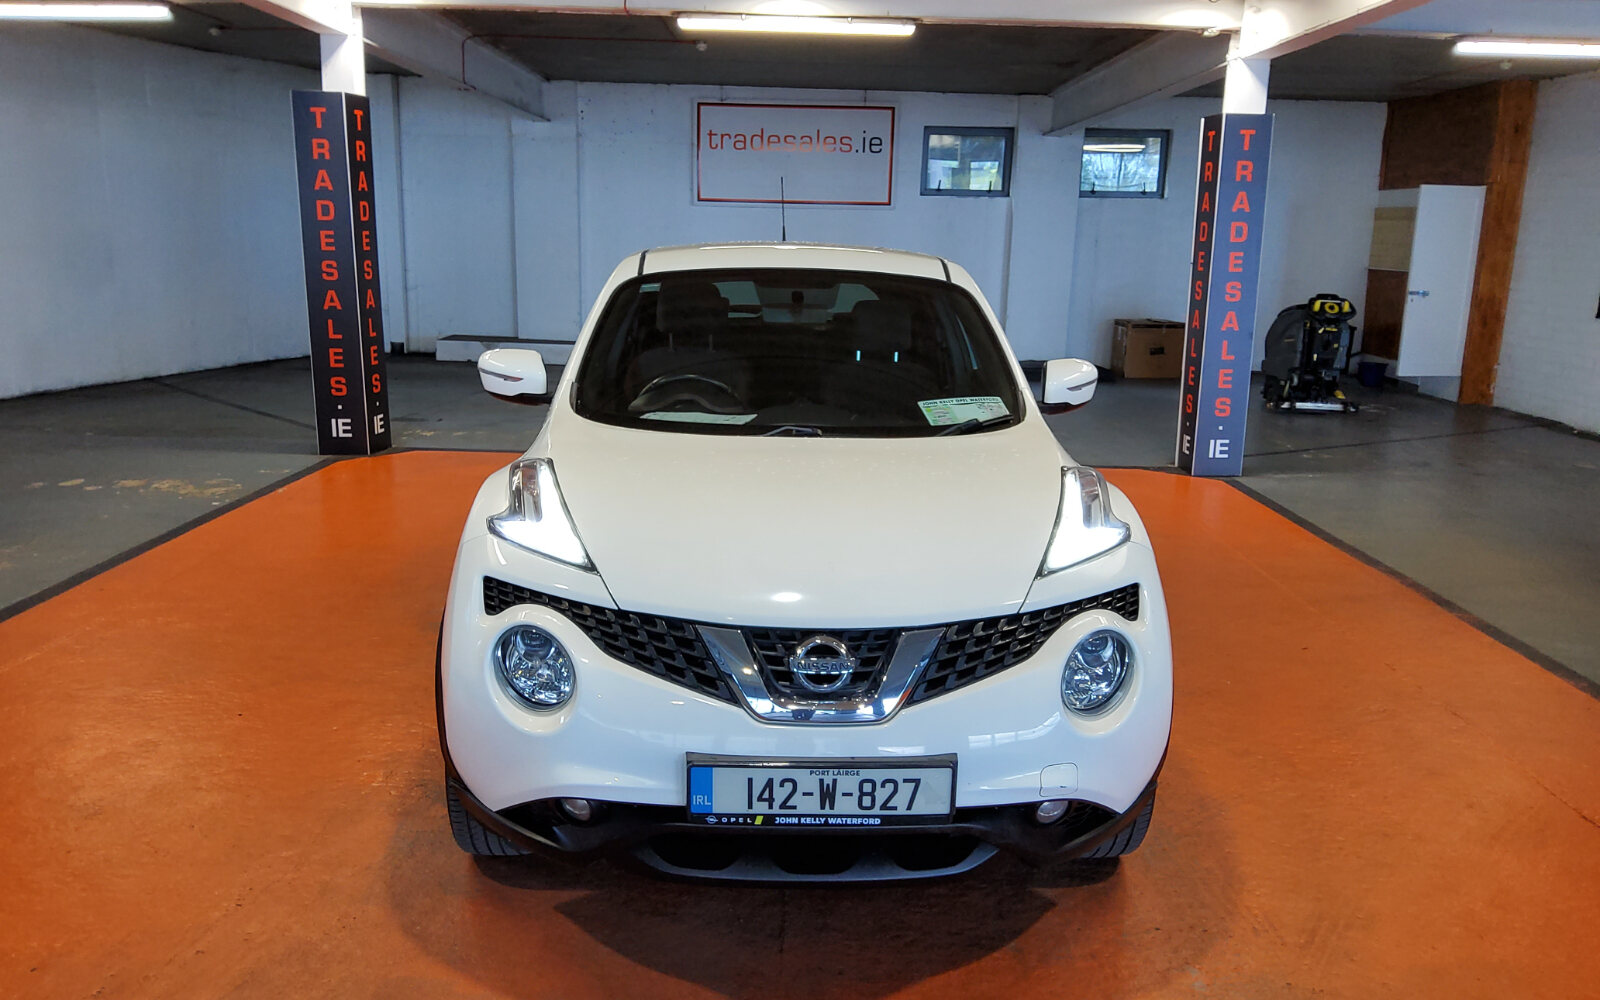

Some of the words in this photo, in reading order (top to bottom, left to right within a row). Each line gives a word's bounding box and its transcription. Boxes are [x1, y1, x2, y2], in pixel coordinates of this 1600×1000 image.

[707, 128, 883, 154] tradesales.ie
[797, 661, 849, 671] NISSAN
[692, 794, 712, 806] IRL
[747, 777, 922, 811] 142-W-827
[828, 817, 881, 825] WATERFORD
